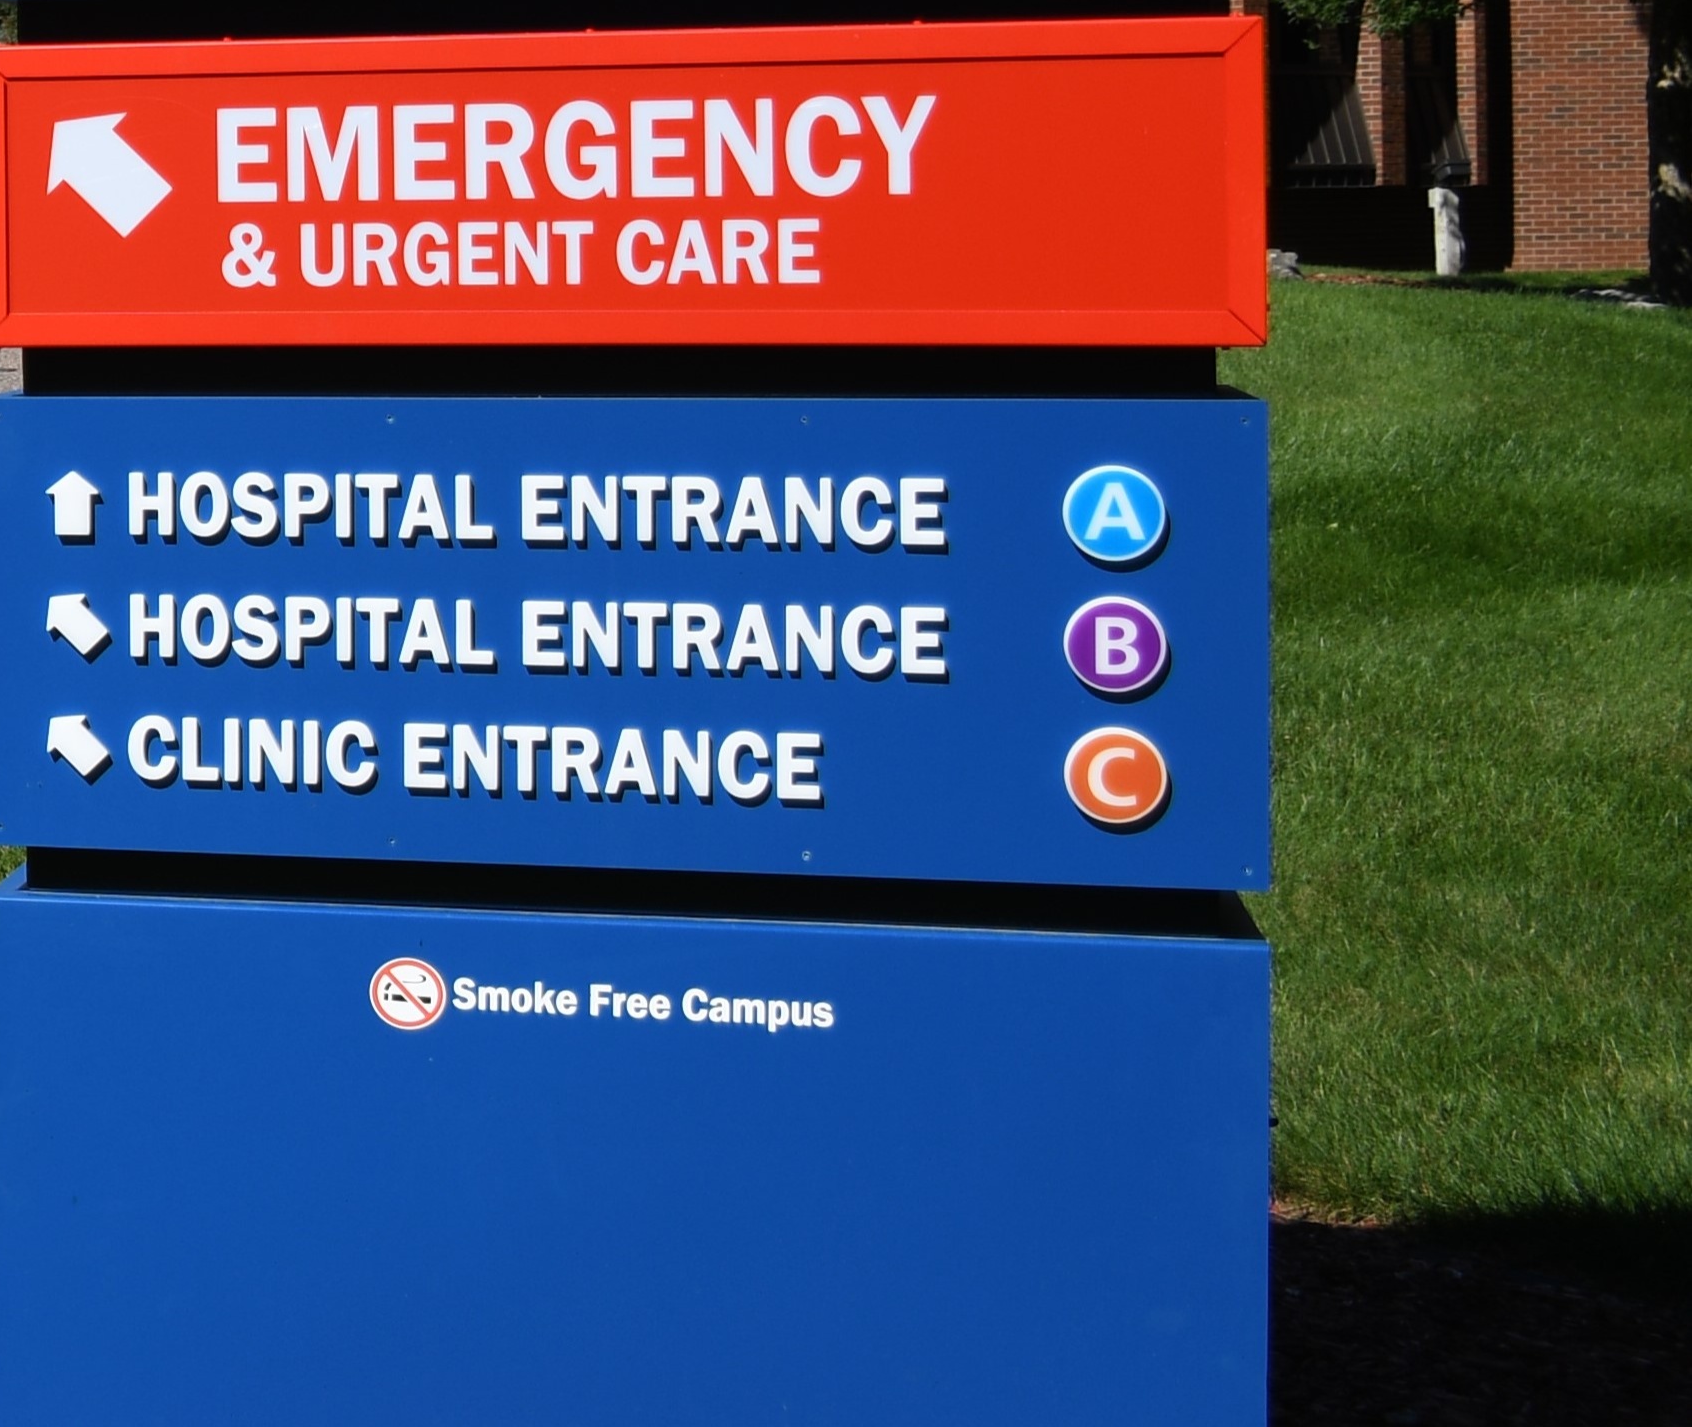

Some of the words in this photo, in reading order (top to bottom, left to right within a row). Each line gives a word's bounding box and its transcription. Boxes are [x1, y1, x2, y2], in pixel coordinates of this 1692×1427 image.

[216, 95, 937, 203] EMERGENCY
[222, 223, 276, 288] &
[300, 220, 594, 287] URGENT
[616, 218, 820, 285] CARE
[129, 471, 493, 540] HOSPITAL
[521, 474, 945, 545] ENTRANCE
[1084, 482, 1145, 540] A
[129, 593, 494, 665] HOSPITAL
[522, 600, 945, 674] ENTRANCE
[1095, 617, 1140, 675] B
[128, 714, 375, 787] CLINIC
[403, 722, 820, 800] ENTRANCE
[1087, 747, 1137, 807] C
[452, 977, 578, 1016] Smoke
[589, 983, 671, 1020] Free
[682, 988, 834, 1033] Campus
